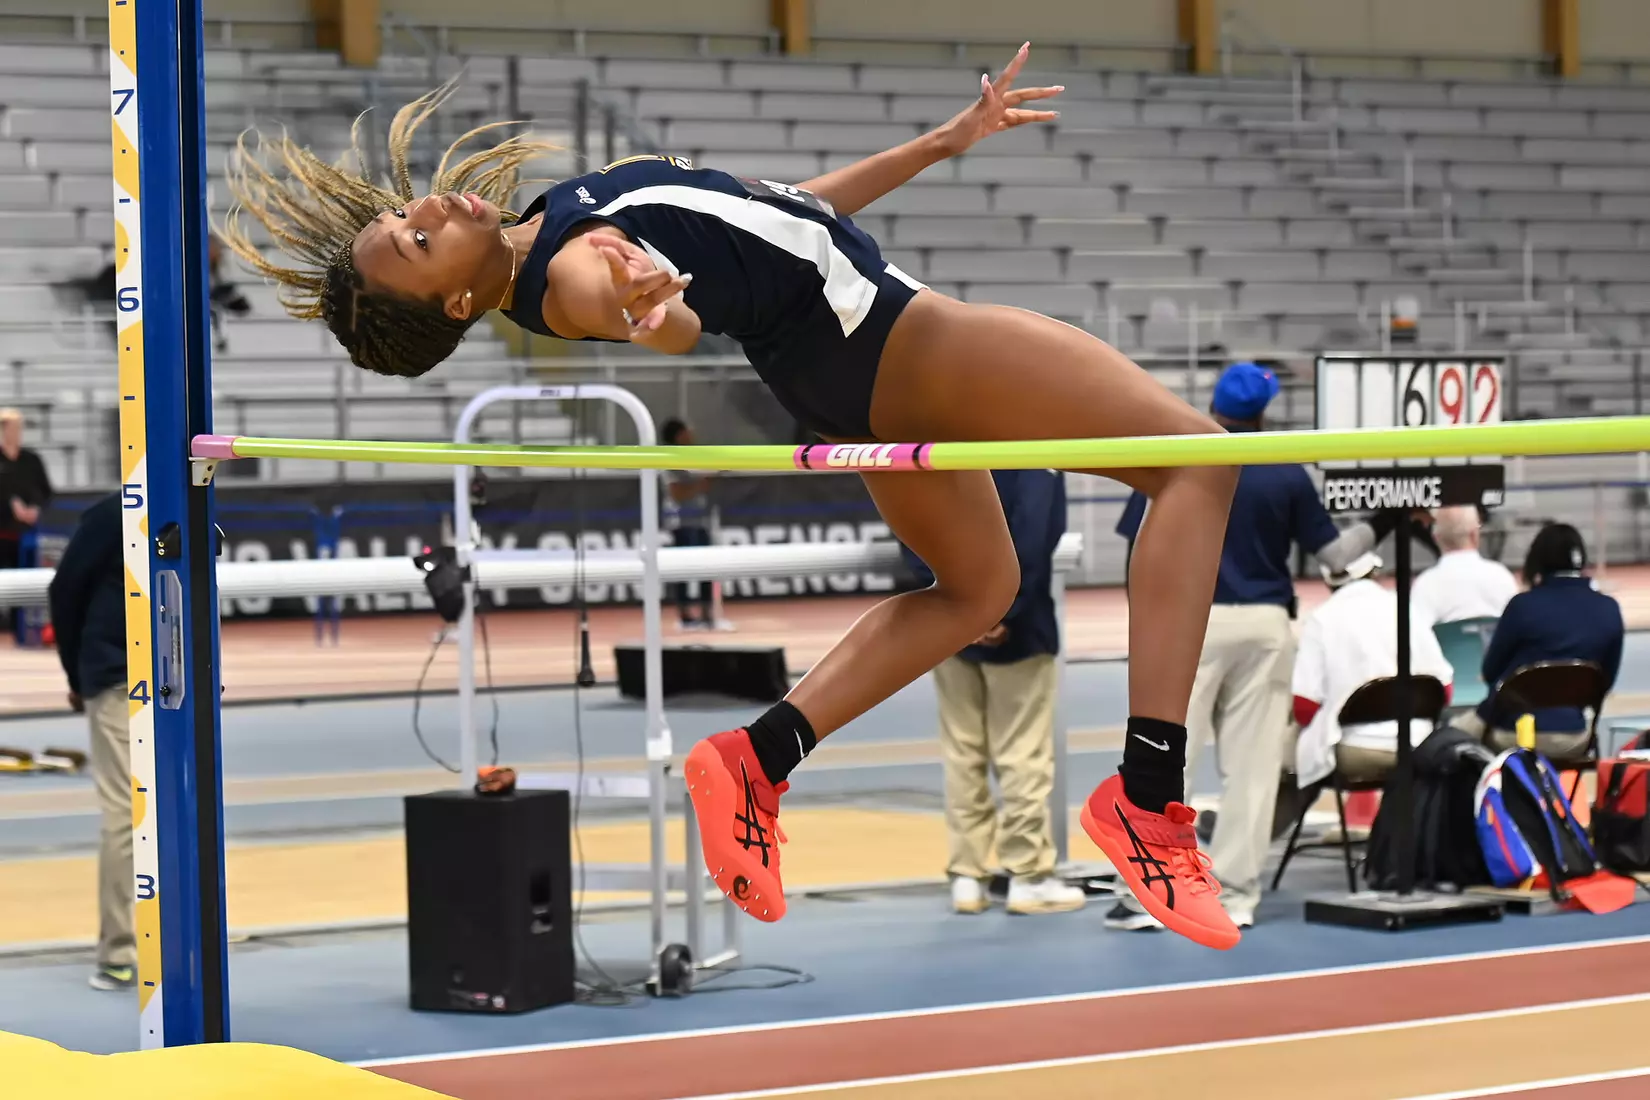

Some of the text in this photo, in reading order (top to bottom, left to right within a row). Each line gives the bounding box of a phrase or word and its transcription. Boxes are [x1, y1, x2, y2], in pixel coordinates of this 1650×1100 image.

[112, 88, 135, 116] 7
[117, 286, 140, 312] 6
[826, 443, 900, 468] GILL
[122, 483, 144, 509] 5
[1325, 477, 1442, 510] PERFORMANCE
[128, 680, 151, 706] 4
[136, 874, 156, 900] 3
